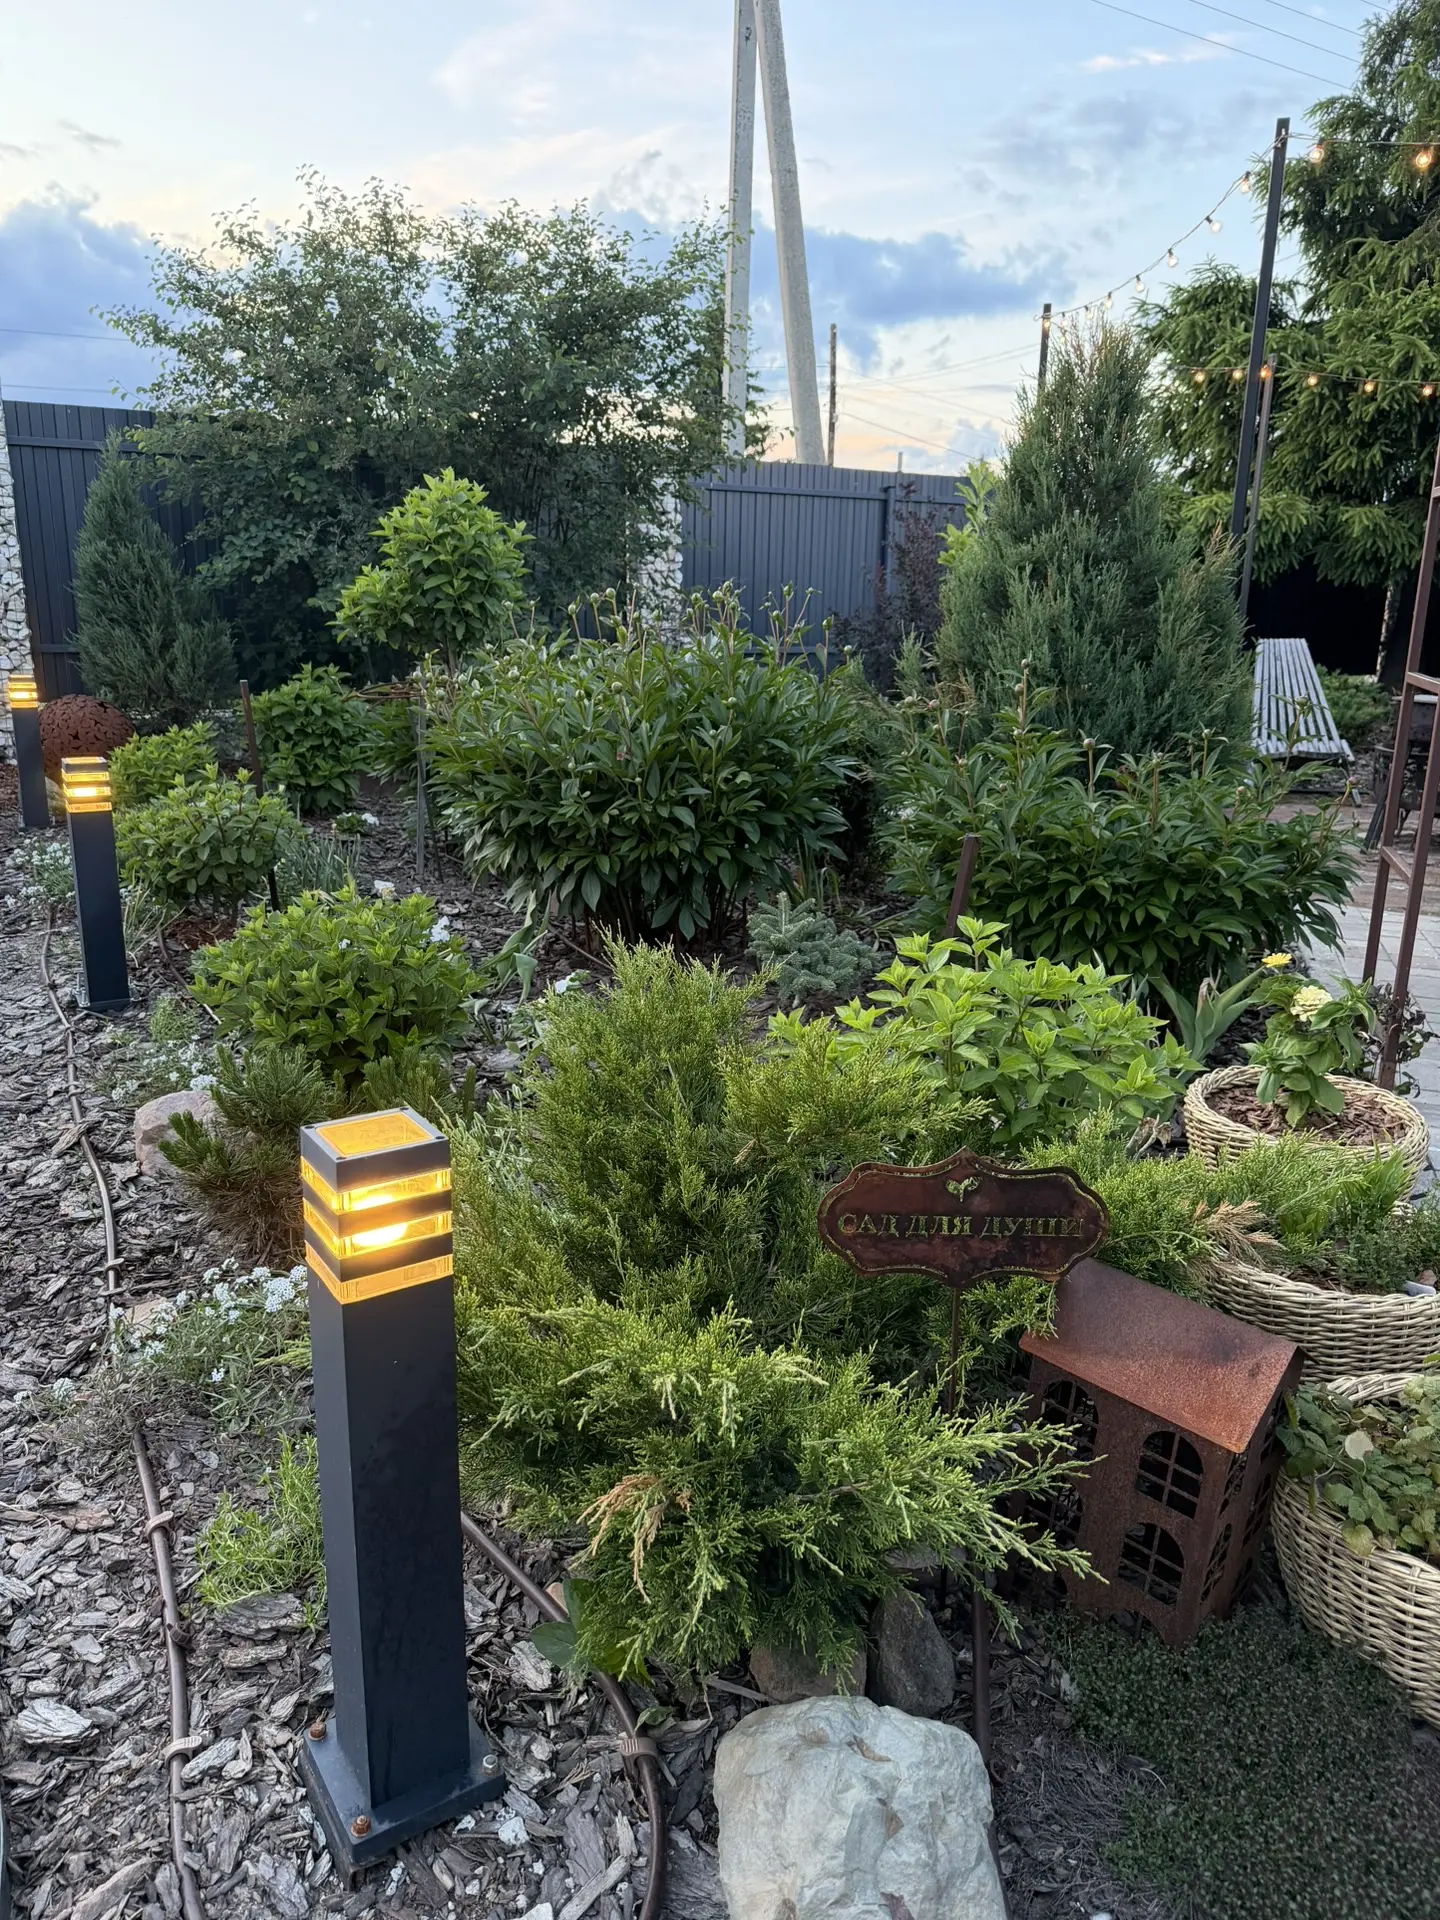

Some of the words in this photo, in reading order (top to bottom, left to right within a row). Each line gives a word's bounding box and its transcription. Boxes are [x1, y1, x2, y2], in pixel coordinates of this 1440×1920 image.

[838, 1213, 899, 1238] САД
[905, 1215, 972, 1238] ДЛЯ
[979, 1217, 1084, 1238] ДУШИ
